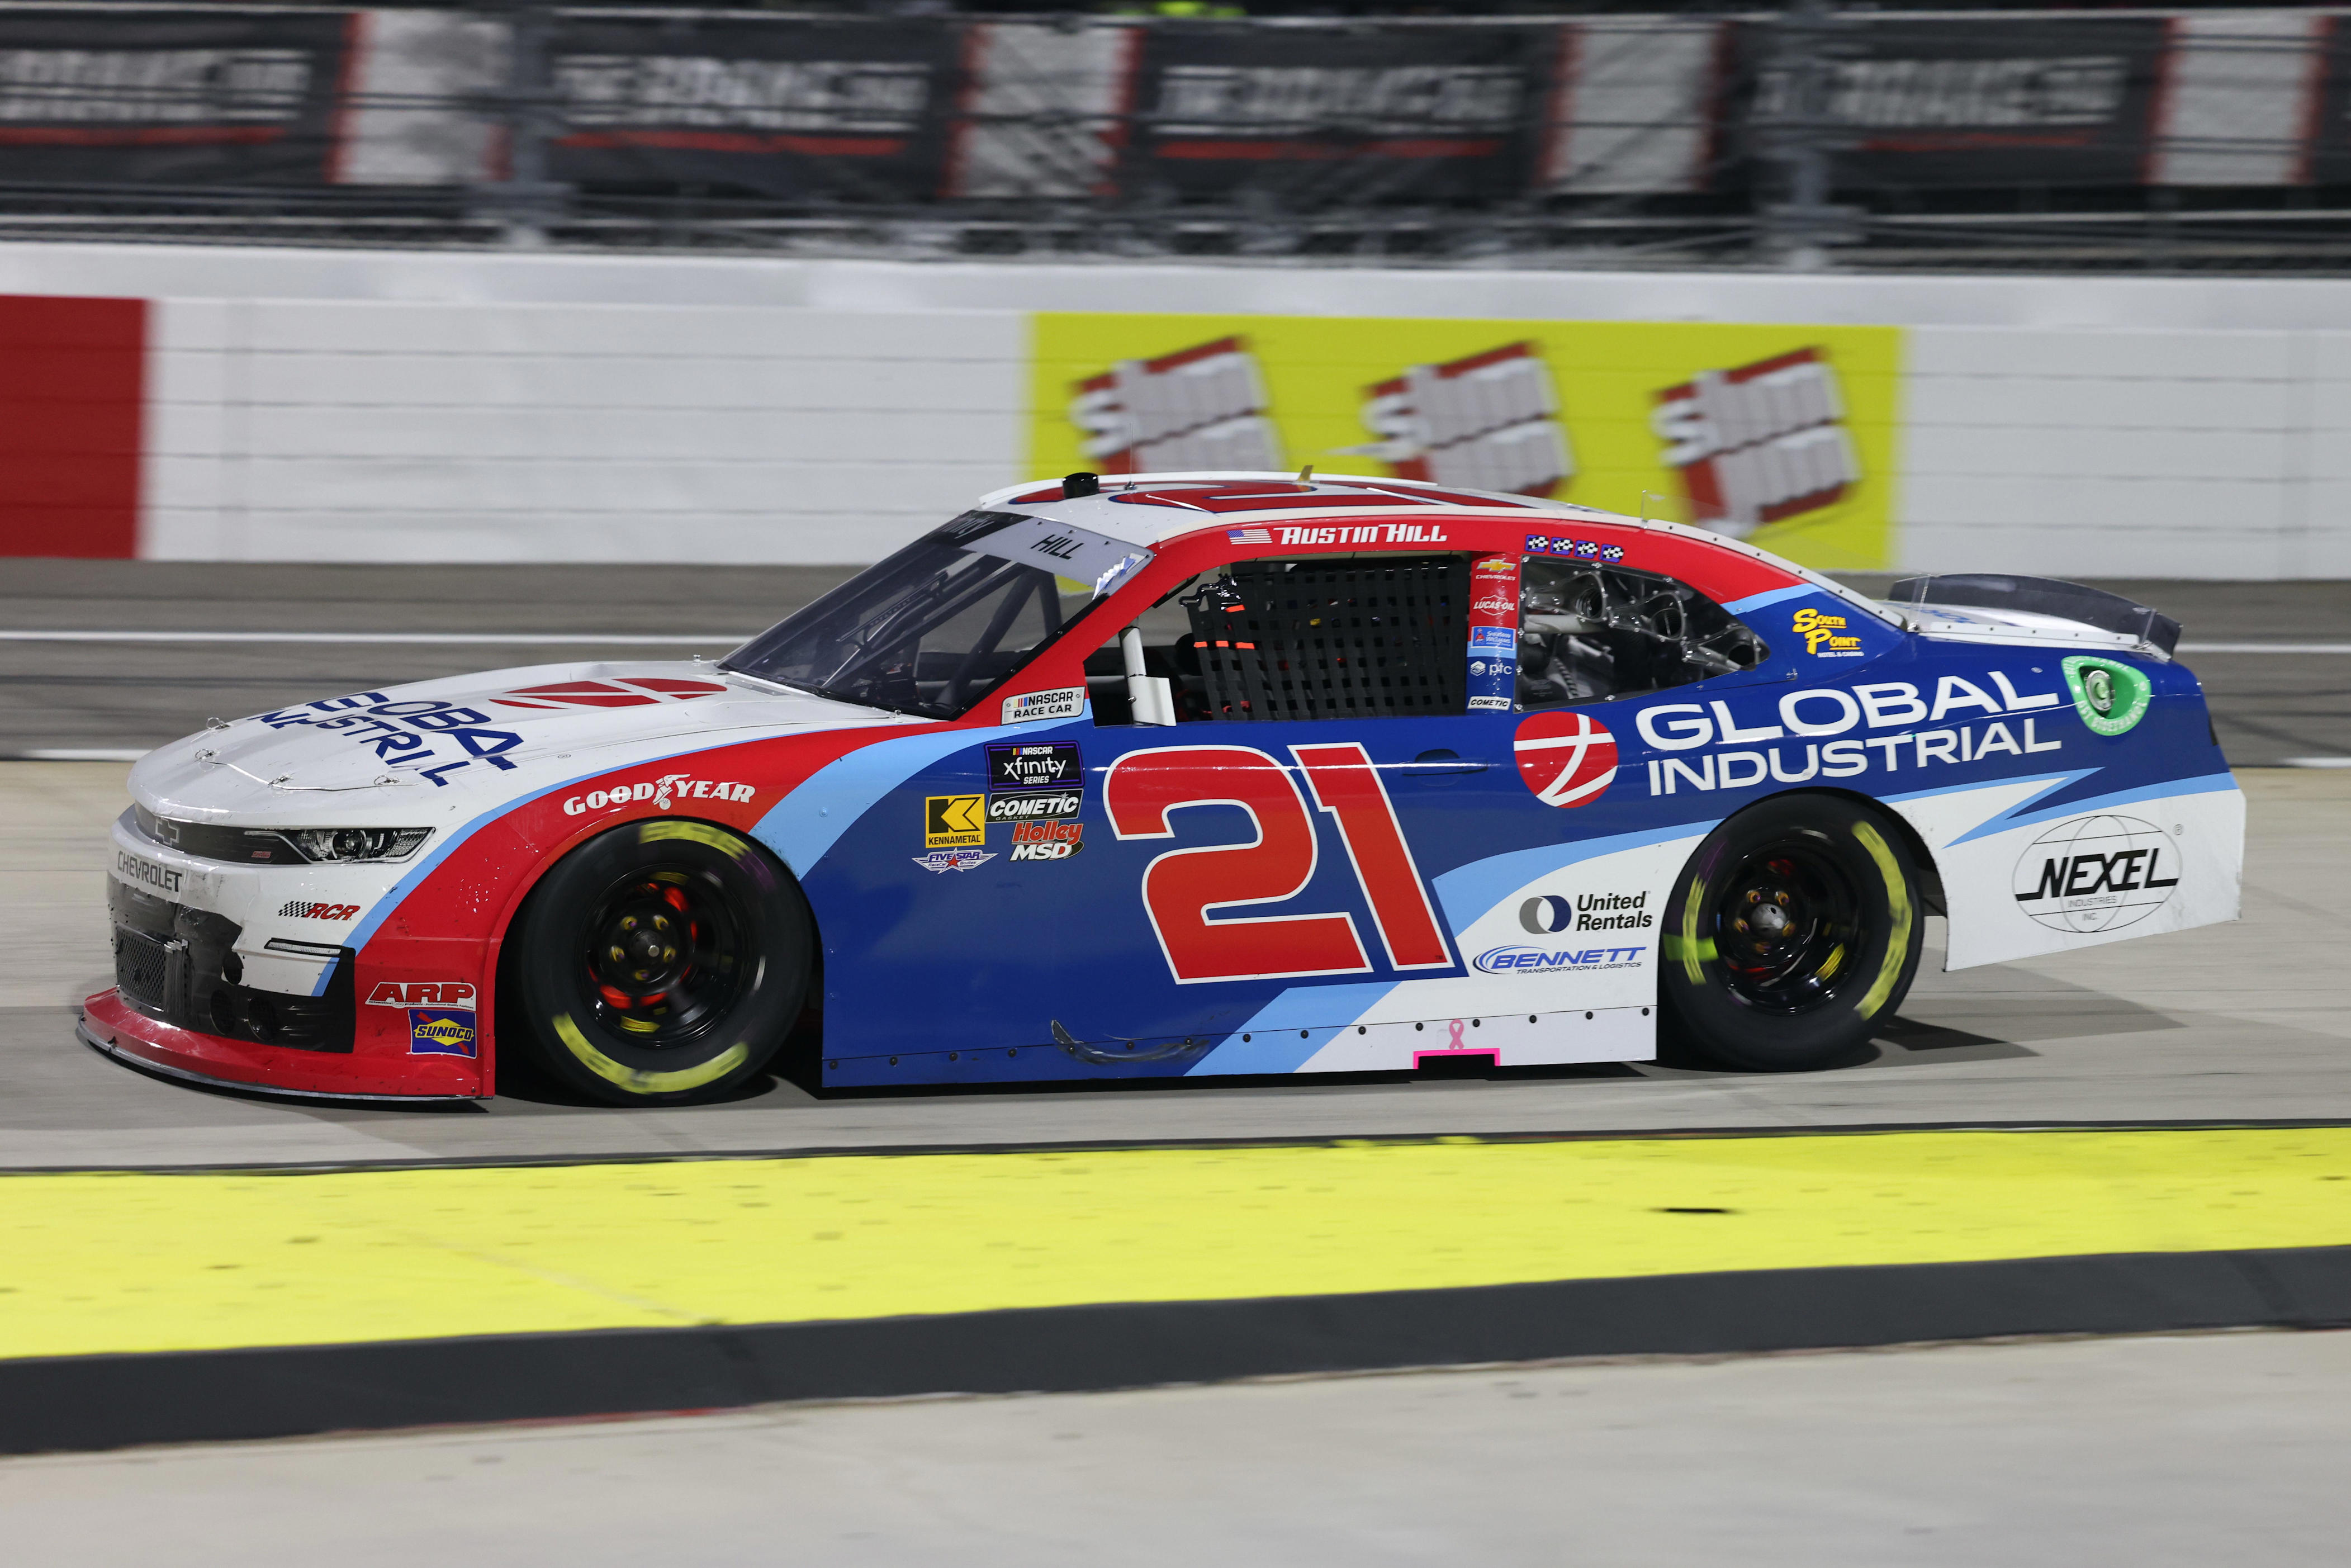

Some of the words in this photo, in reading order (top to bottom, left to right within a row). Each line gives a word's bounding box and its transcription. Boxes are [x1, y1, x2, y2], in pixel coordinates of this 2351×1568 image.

[1378, 523, 1447, 542] HILL
[1030, 534, 1084, 560] HILL
[1489, 662, 1513, 676] ptc
[1028, 691, 1074, 706] NASCAR
[1471, 698, 1509, 707] COMETIC
[1014, 707, 1045, 718] RACE
[1049, 704, 1072, 713] CAR
[1635, 671, 2060, 751] GLOBAL
[1022, 746, 1053, 755] NASCAR
[1647, 718, 2062, 797] INDUSTRIAL
[1003, 757, 1067, 780] xfinity
[1023, 776, 1050, 784] SERIES
[990, 797, 1079, 817] COMETIC
[928, 835, 980, 845] KENNAMETAL
[1012, 820, 1084, 846] Holley
[928, 854, 952, 863] FIVE
[1009, 842, 1072, 861] MSD
[117, 850, 183, 893] CHEVROLET
[1103, 742, 1456, 985] 21
[2015, 847, 2179, 902] NEXEL
[1577, 890, 1647, 912] United
[2068, 896, 2118, 908] INDUSTRIES
[304, 903, 361, 921] RCR
[1576, 911, 1653, 932] Rentals
[1491, 946, 1647, 969] BENNETT
[1516, 965, 1591, 974] TRANSPORTATION
[369, 983, 475, 1003] ARP
[417, 1026, 473, 1040] SUNOCO
